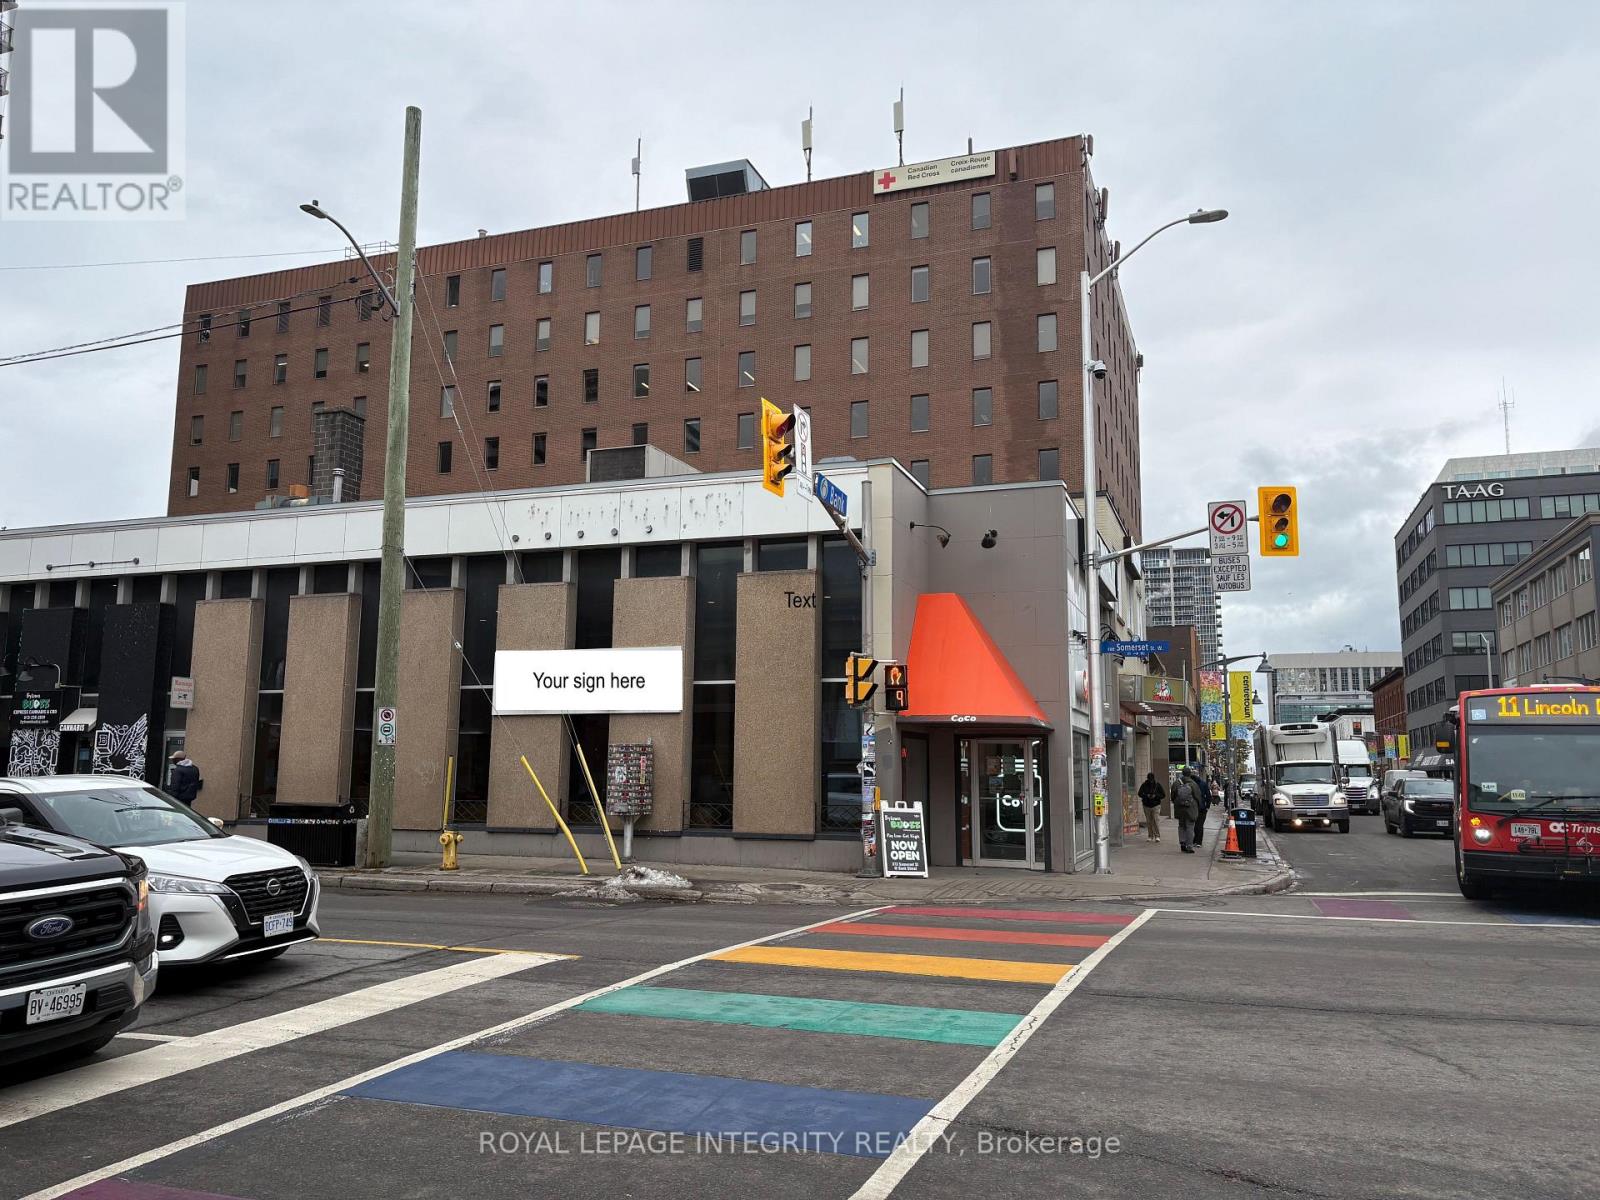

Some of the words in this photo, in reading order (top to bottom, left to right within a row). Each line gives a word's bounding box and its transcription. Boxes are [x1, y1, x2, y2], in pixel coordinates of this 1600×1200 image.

[950, 155, 991, 167] Croix-Rouge
[907, 164, 938, 174] Canadian
[950, 163, 989, 174] canadienne
[907, 173, 920, 181] Red
[921, 171, 940, 179] Cross
[1442, 482, 1505, 499] TAAG
[829, 486, 845, 514] Bank
[1218, 556, 1241, 565] BUSES
[1213, 564, 1247, 573] EXCEPTED
[1216, 574, 1231, 582] SAUF
[1233, 573, 1245, 581] LES
[1116, 643, 1149, 652] Somerset
[896, 690, 904, 707] 9
[1243, 675, 1251, 718] centretown
[1498, 696, 1521, 717] 11
[1524, 698, 1589, 715] Lincoln
[60, 724, 85, 732] CANNABIS
[891, 841, 917, 851] NOW
[891, 851, 920, 860] OPEN
[40, 920, 64, 935] Ford
